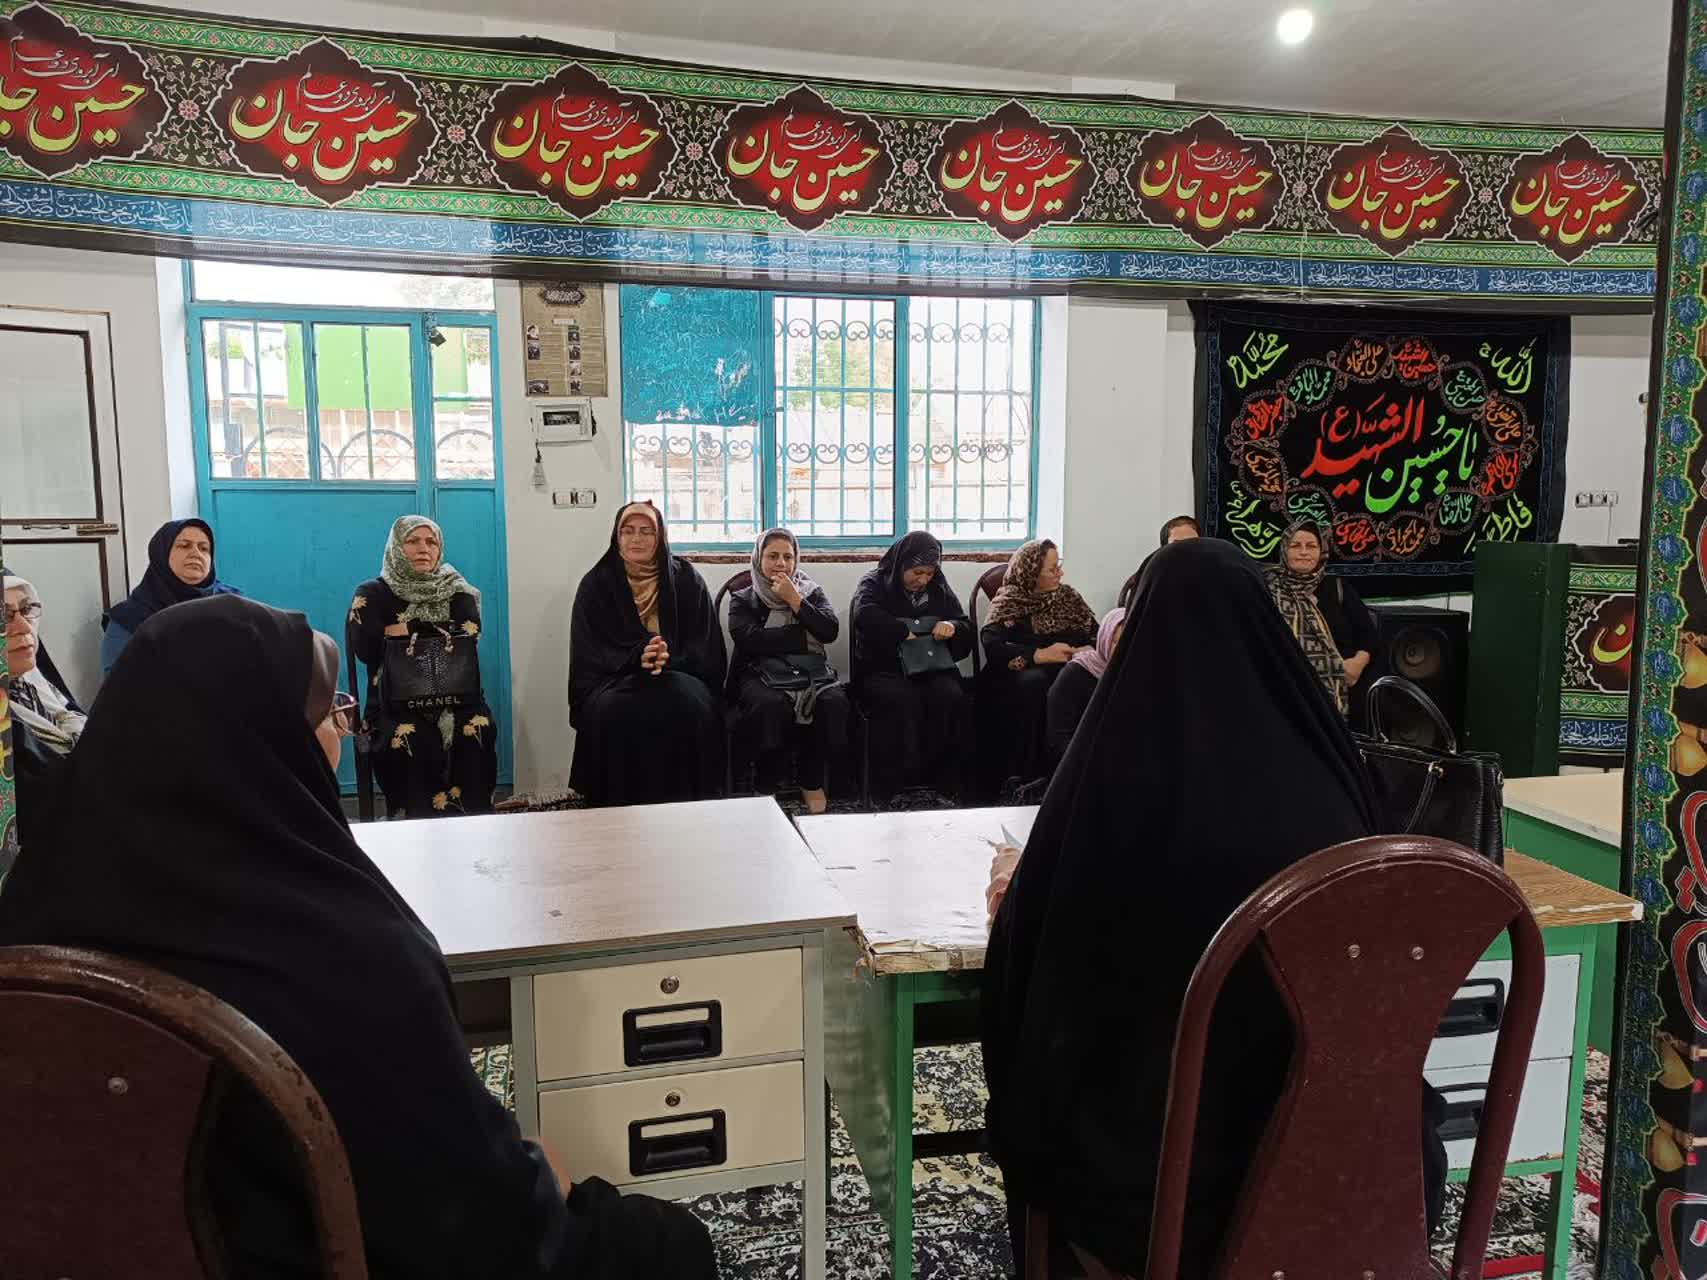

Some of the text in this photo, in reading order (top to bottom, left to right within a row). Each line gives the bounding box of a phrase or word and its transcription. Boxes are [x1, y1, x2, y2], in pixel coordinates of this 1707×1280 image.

[28, 84, 145, 151] حسین
[231, 89, 417, 182] حسین جان
[494, 109, 659, 196] حسین جان
[727, 129, 880, 211] حسین جان
[942, 142, 1082, 221] حسین جان
[1139, 153, 1272, 229] حسین جان
[1327, 164, 1459, 240] حسین جان
[1511, 172, 1636, 244] حسین جان
[1301, 393, 1425, 498] الشهید
[1365, 427, 1464, 513] حسین
[407, 696, 461, 709] CHANEL
